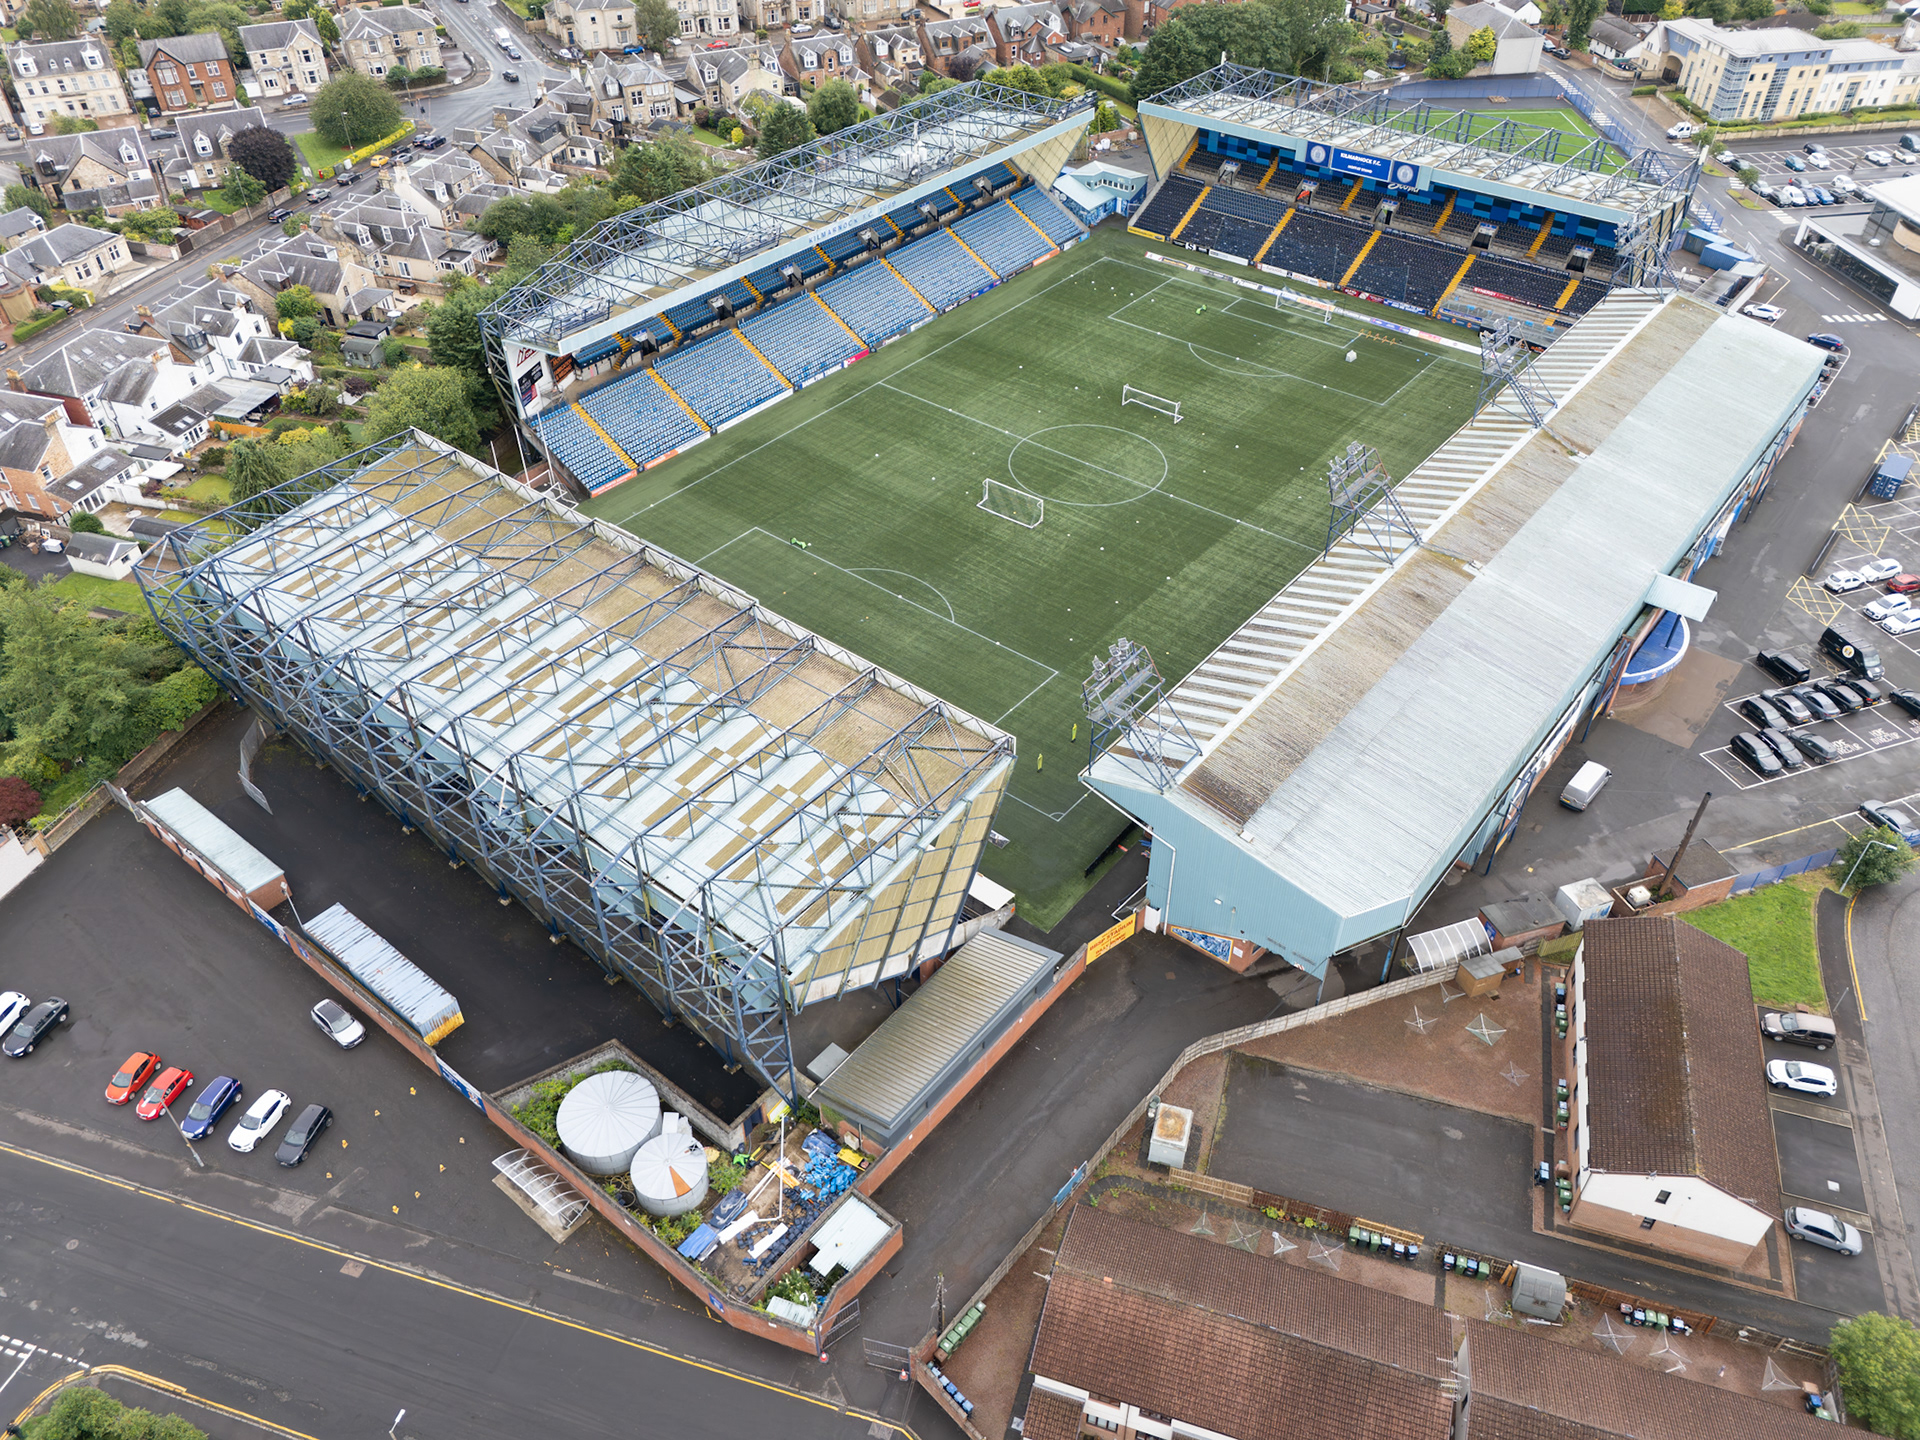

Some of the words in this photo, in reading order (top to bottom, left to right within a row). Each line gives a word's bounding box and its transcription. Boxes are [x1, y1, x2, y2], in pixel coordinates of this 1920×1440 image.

[1340, 152, 1372, 164] KILMARNOCK
[808, 218, 858, 243] KILMARNOCK
[879, 200, 896, 213] 1869
[1868, 728, 1885, 737] HOME
[1869, 731, 1902, 745] DIRECTOR
[1836, 742, 1863, 755] IRECTOR
[1106, 920, 1133, 939] STADIUM
